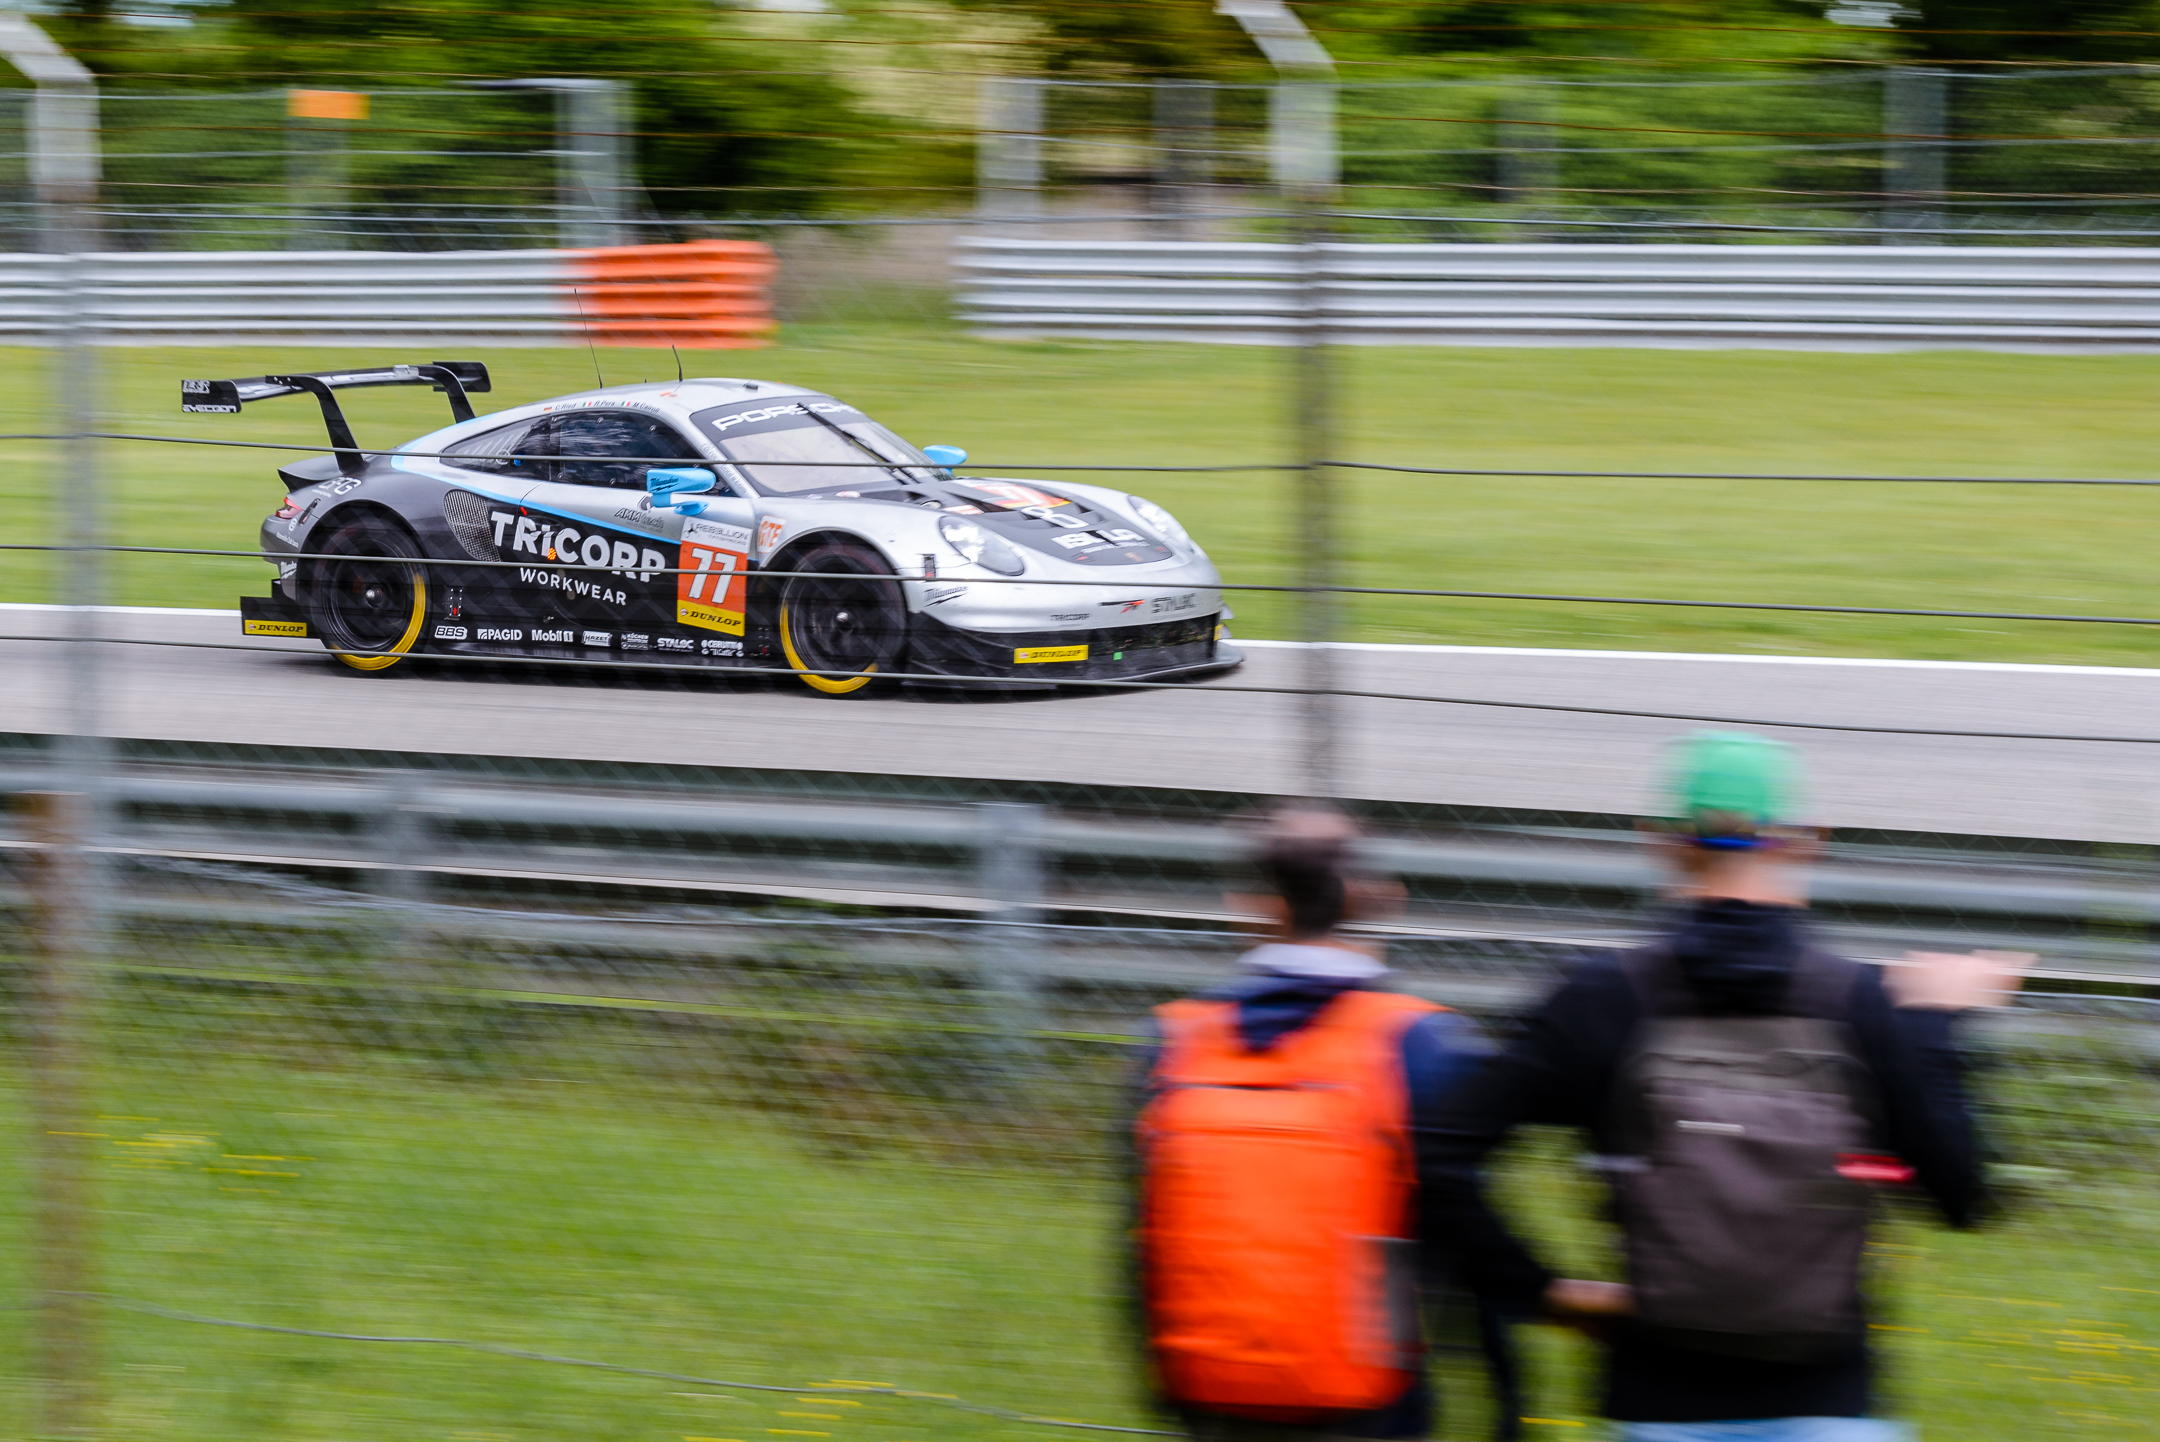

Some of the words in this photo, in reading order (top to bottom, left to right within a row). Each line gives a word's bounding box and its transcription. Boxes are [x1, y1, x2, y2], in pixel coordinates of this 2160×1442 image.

[688, 547, 738, 605] 77
[519, 567, 627, 606] WORKWEAR
[689, 610, 742, 627] DUNLOP
[256, 623, 304, 633] DUNLOP
[435, 626, 468, 640] BBS
[487, 629, 523, 641] PAGID
[531, 629, 563, 642] Mobil
